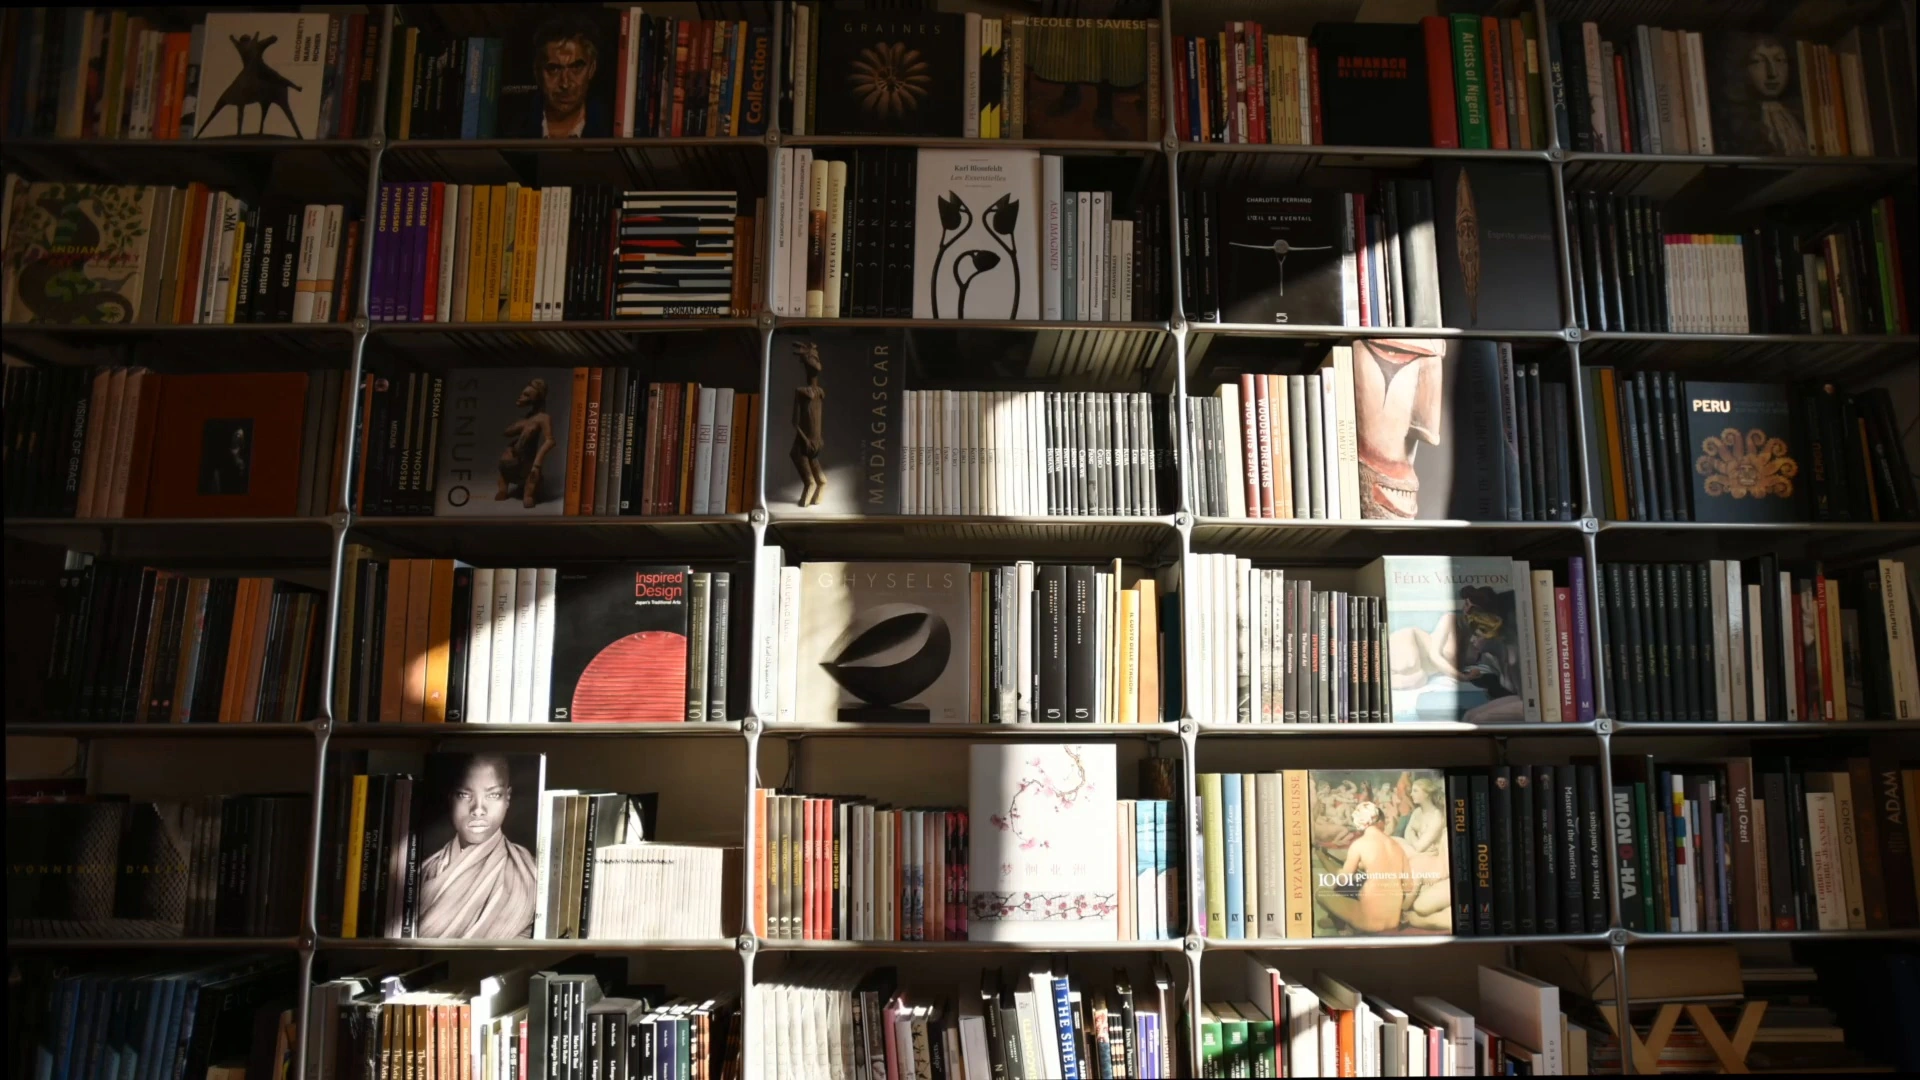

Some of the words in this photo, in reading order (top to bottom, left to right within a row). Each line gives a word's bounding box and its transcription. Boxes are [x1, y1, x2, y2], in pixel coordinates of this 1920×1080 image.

[844, 22, 941, 35] GRAINES
[1076, 19, 1095, 29] DE
[303, 36, 312, 62] MARINI
[1461, 32, 1475, 68] Artists
[746, 36, 769, 125] Collection
[1465, 69, 1477, 82] of
[1465, 84, 1481, 125] Nigeria
[954, 164, 969, 172] Karl
[378, 186, 389, 232] FUTURISMO
[391, 187, 402, 233] FUTURISMO
[405, 186, 415, 227] FUTURISM
[419, 186, 429, 227] FUTURISM
[261, 227, 274, 255] saura
[829, 233, 837, 256] KLEIN
[258, 256, 272, 295] antonio
[280, 254, 294, 288] erotica
[699, 306, 720, 316] SPACE
[431, 378, 443, 418] PERSONA
[1245, 401, 1254, 427] BOIS
[1692, 399, 1731, 413] PERU
[74, 399, 87, 438] VISIONS
[586, 402, 598, 456] BABEMBE
[868, 344, 889, 505] MADAGASCAR
[1258, 398, 1268, 442] WOODEN
[71, 440, 82, 455] OF
[448, 377, 478, 507] SENUFO
[1247, 428, 1255, 450] SUR
[66, 456, 79, 492] GRACE
[399, 450, 410, 490] PERSONA
[412, 450, 423, 490] PERSONA
[1260, 445, 1270, 488] DREAMS
[635, 571, 683, 587] Inspired
[635, 583, 682, 601] Design
[818, 572, 953, 588] GHYSELS
[1434, 572, 1509, 584] VALLOTTON
[1884, 568, 1893, 598] PICASSO
[475, 604, 485, 620] The
[496, 593, 508, 613] The
[520, 604, 530, 620] The
[1576, 578, 1585, 634] PHOTOGRAPHIES
[1888, 599, 1898, 640] SCULPTURE
[1561, 632, 1570, 669] D'ISLAM
[1563, 671, 1573, 706] TERRES
[1292, 775, 1302, 816] SUISSE
[1564, 786, 1573, 817] Masters
[1736, 787, 1747, 813] Yigal
[1882, 770, 1902, 825] ADAM
[1293, 821, 1303, 836] EN
[1454, 799, 1466, 832] PERU
[1567, 818, 1574, 828] of
[1589, 811, 1598, 853] Amériques
[1841, 800, 1853, 845] KONGO
[1567, 829, 1575, 841] the
[1292, 840, 1304, 899] BYZANCE
[1477, 843, 1489, 888] PÉROU
[1568, 843, 1577, 880] Americas
[1591, 854, 1599, 868] des
[1056, 995, 1070, 1028] THE
[382, 1048, 391, 1062] The
[394, 1049, 402, 1062] The
[418, 1049, 426, 1064] The
[1061, 1032, 1076, 1078] SHELL
